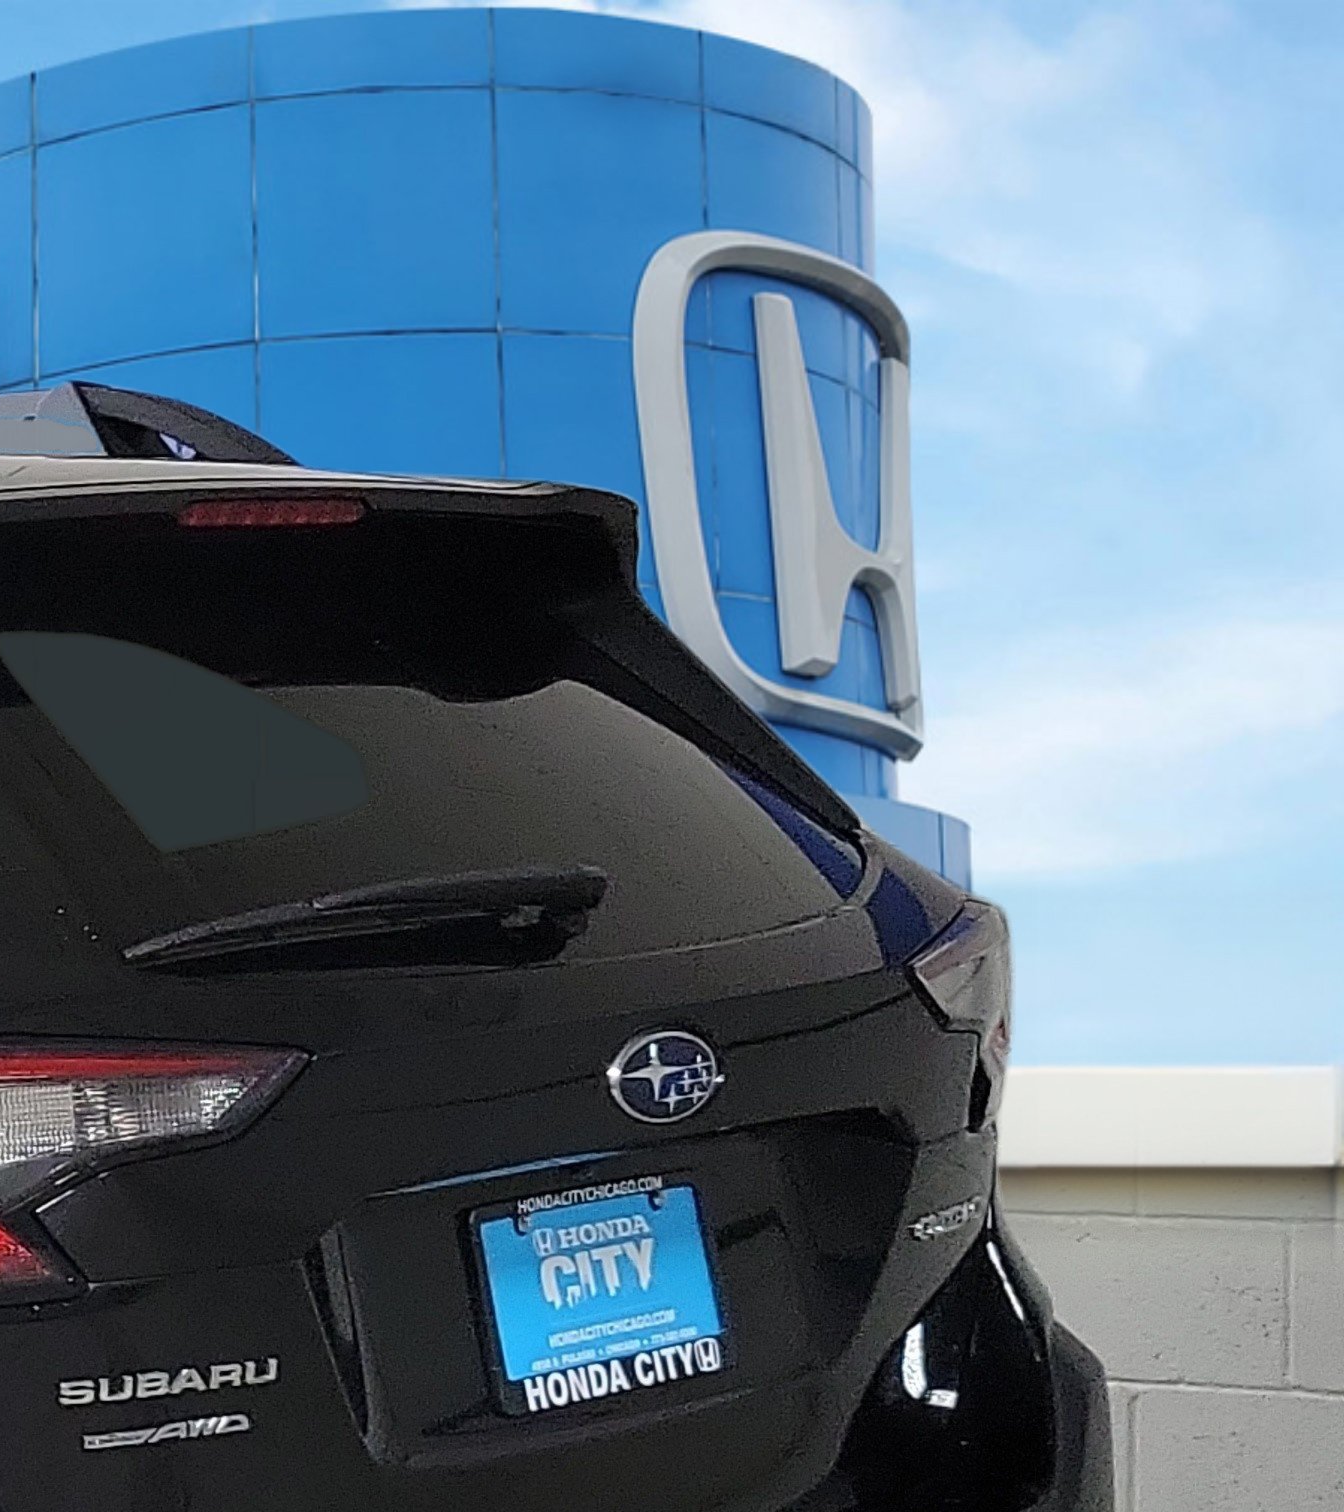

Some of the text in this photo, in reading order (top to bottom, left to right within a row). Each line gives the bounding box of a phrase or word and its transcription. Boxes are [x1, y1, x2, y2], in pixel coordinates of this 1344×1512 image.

[516, 1175, 663, 1214] HONDACITYCHICAGO.COM
[557, 1214, 650, 1248] HONDA
[539, 1237, 655, 1310] CITY
[58, 1357, 279, 1405] SUBARU
[523, 1342, 696, 1412] HONDA CITY
[147, 1413, 251, 1444] AWD
